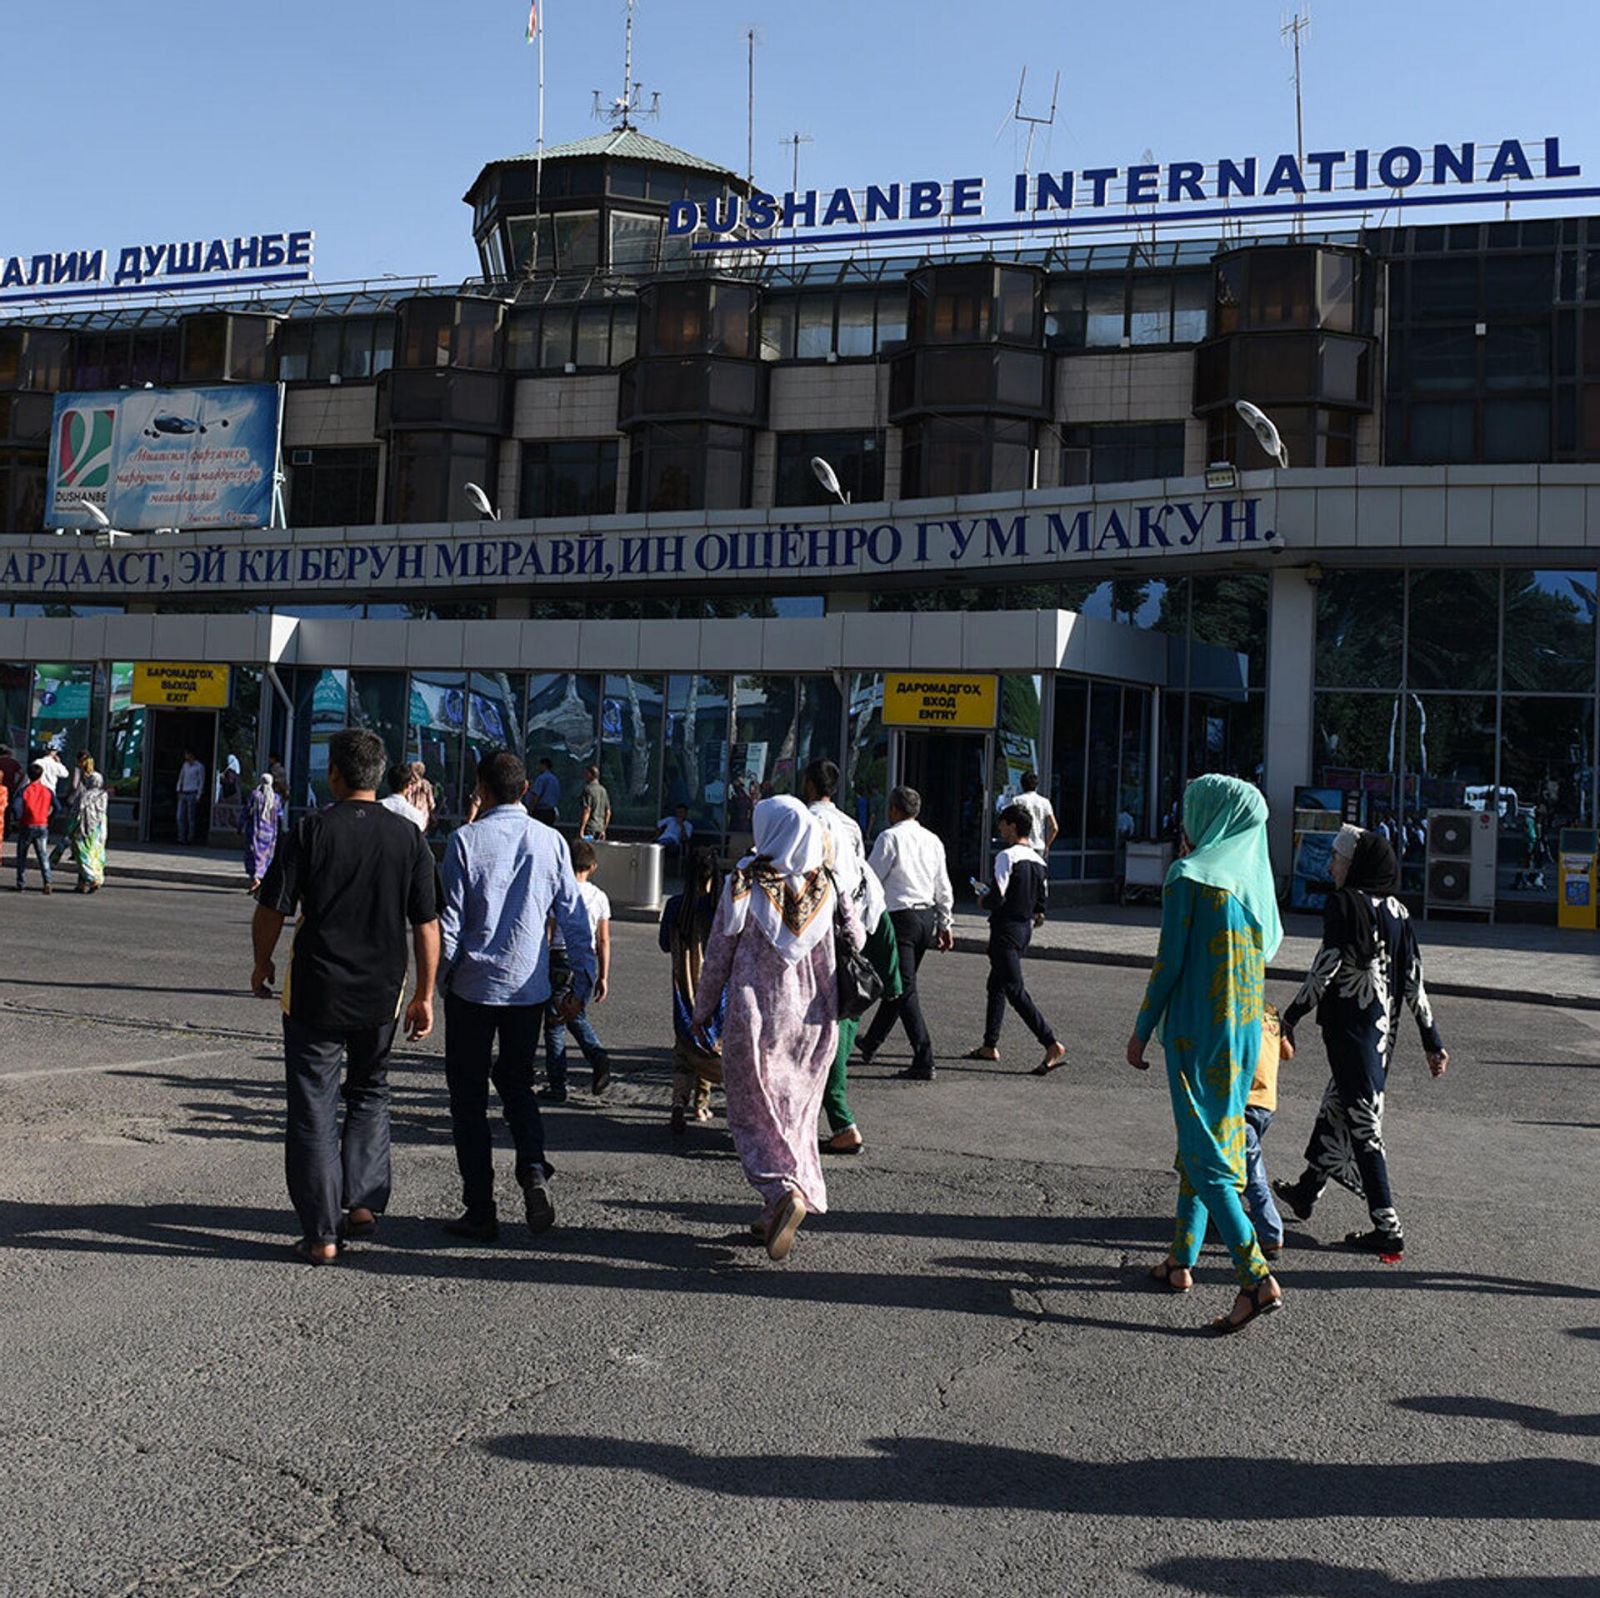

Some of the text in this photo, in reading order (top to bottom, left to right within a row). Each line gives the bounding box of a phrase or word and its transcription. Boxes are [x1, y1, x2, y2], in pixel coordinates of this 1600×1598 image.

[668, 136, 1581, 235] DUSHANBE INTERNATIONAL
[114, 231, 313, 285] ДУШАНБЕ
[56, 491, 107, 502] DUSHANBE
[178, 545, 228, 584] ЭЙ
[236, 548, 290, 583] КИ
[297, 544, 427, 582] БЕРУН
[619, 535, 688, 573] ИН
[695, 523, 901, 572] ОШЁНРО
[913, 515, 1031, 562] ГУМ
[1044, 498, 1275, 555] МАКУН.
[161, 681, 196, 691] ВЫХОД
[166, 693, 188, 702] EXIT
[923, 696, 956, 708] ВХОД
[919, 709, 957, 719] ENTRY
